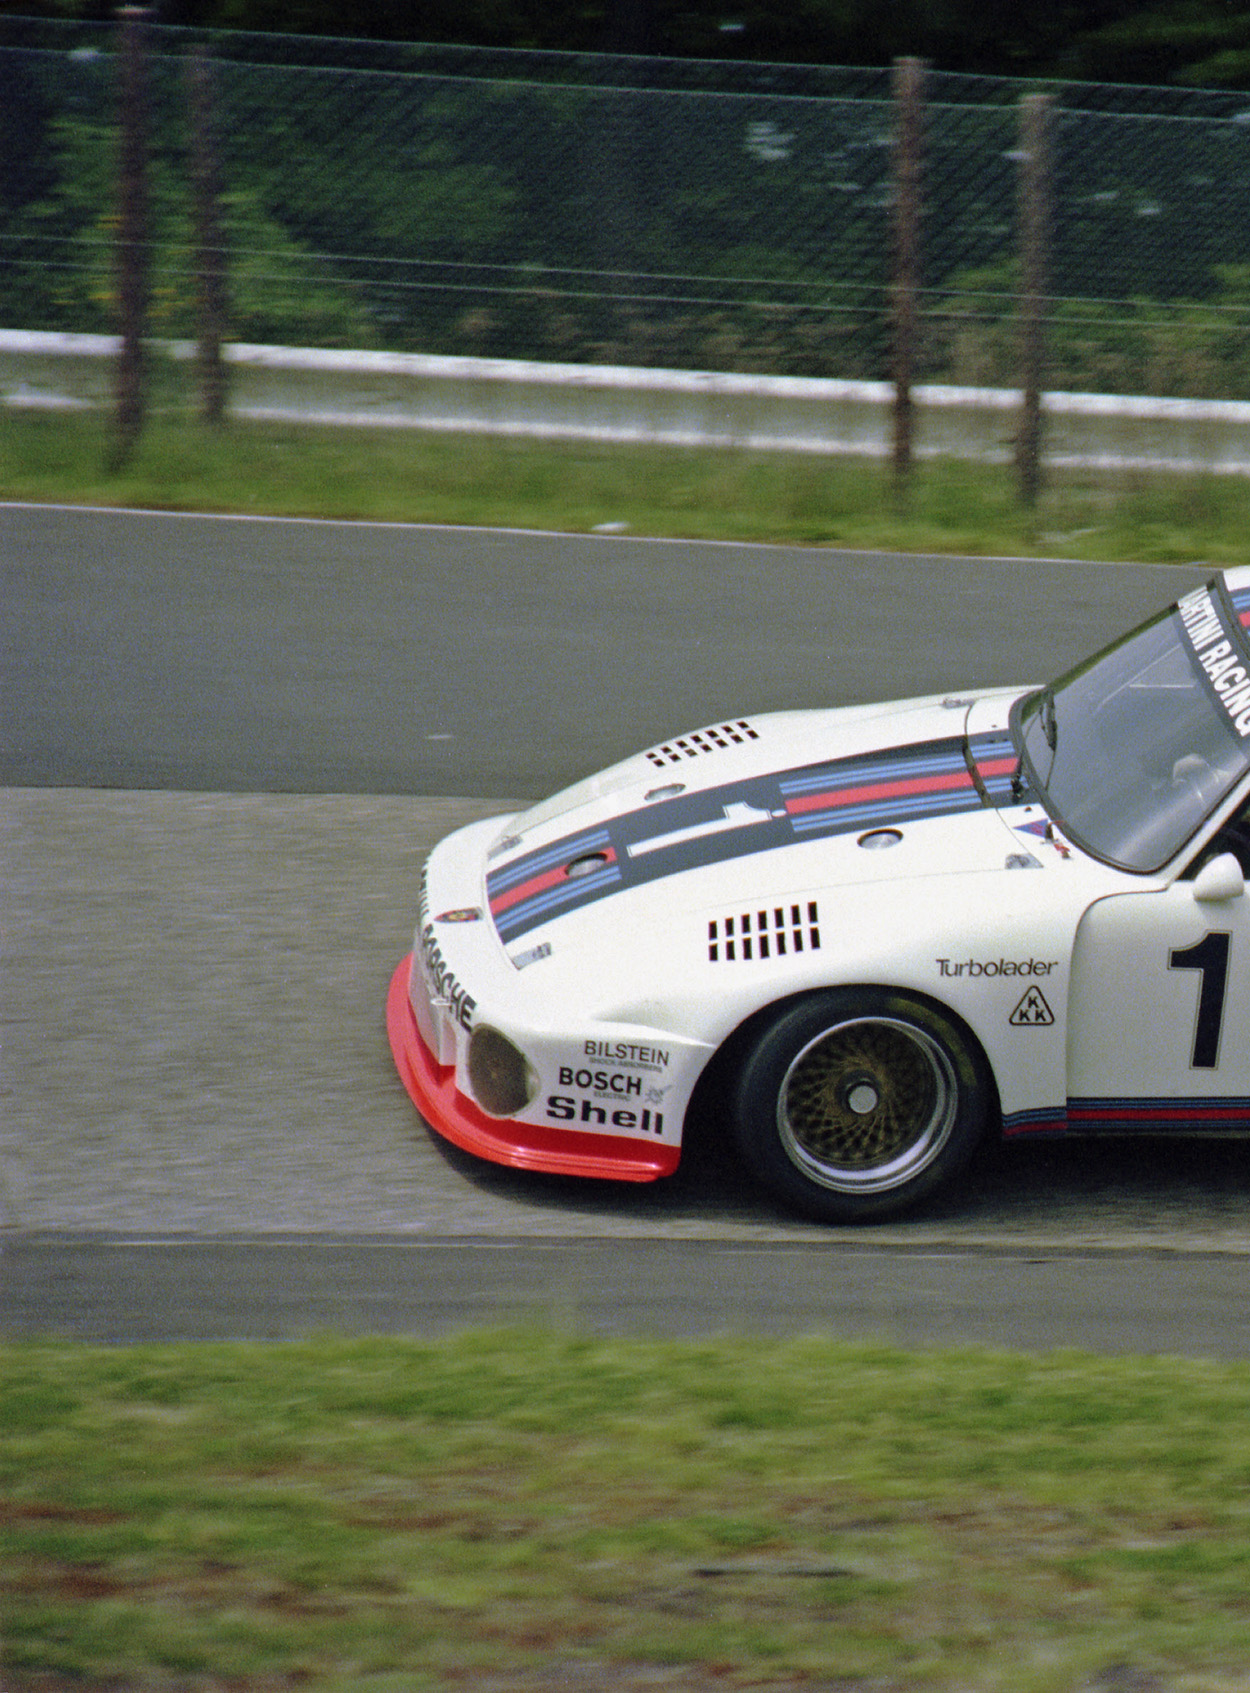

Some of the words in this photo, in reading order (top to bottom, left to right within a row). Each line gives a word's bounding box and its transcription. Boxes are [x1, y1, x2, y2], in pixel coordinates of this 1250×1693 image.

[935, 958, 1058, 977] Turbolader
[1168, 931, 1231, 1069] 1
[584, 1040, 670, 1066] BILSTEIN
[559, 1066, 642, 1096] BOSCH
[546, 1096, 664, 1135] Shell
